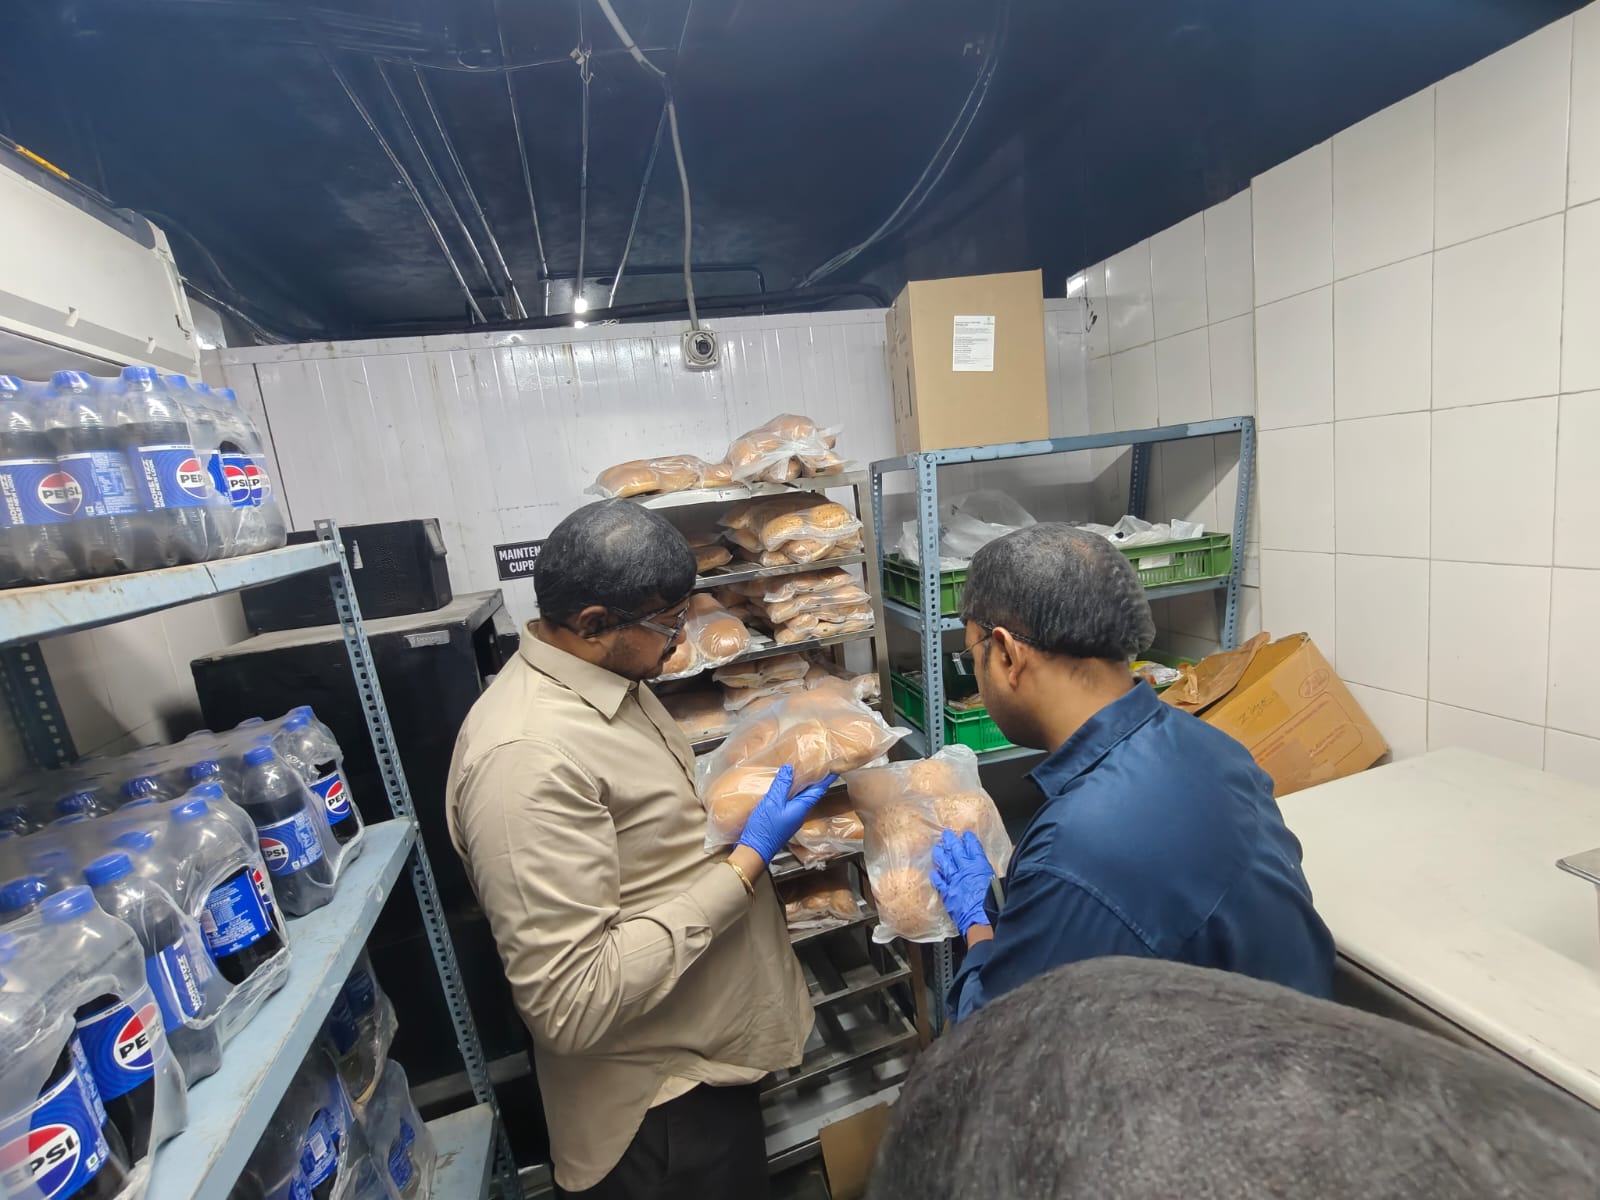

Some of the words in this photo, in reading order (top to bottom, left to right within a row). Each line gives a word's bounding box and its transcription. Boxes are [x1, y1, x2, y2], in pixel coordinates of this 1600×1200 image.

[230, 479, 250, 488] PSI
[499, 546, 541, 560] MAINTEN
[509, 560, 534, 572] CUPB
[263, 848, 286, 858] PSI
